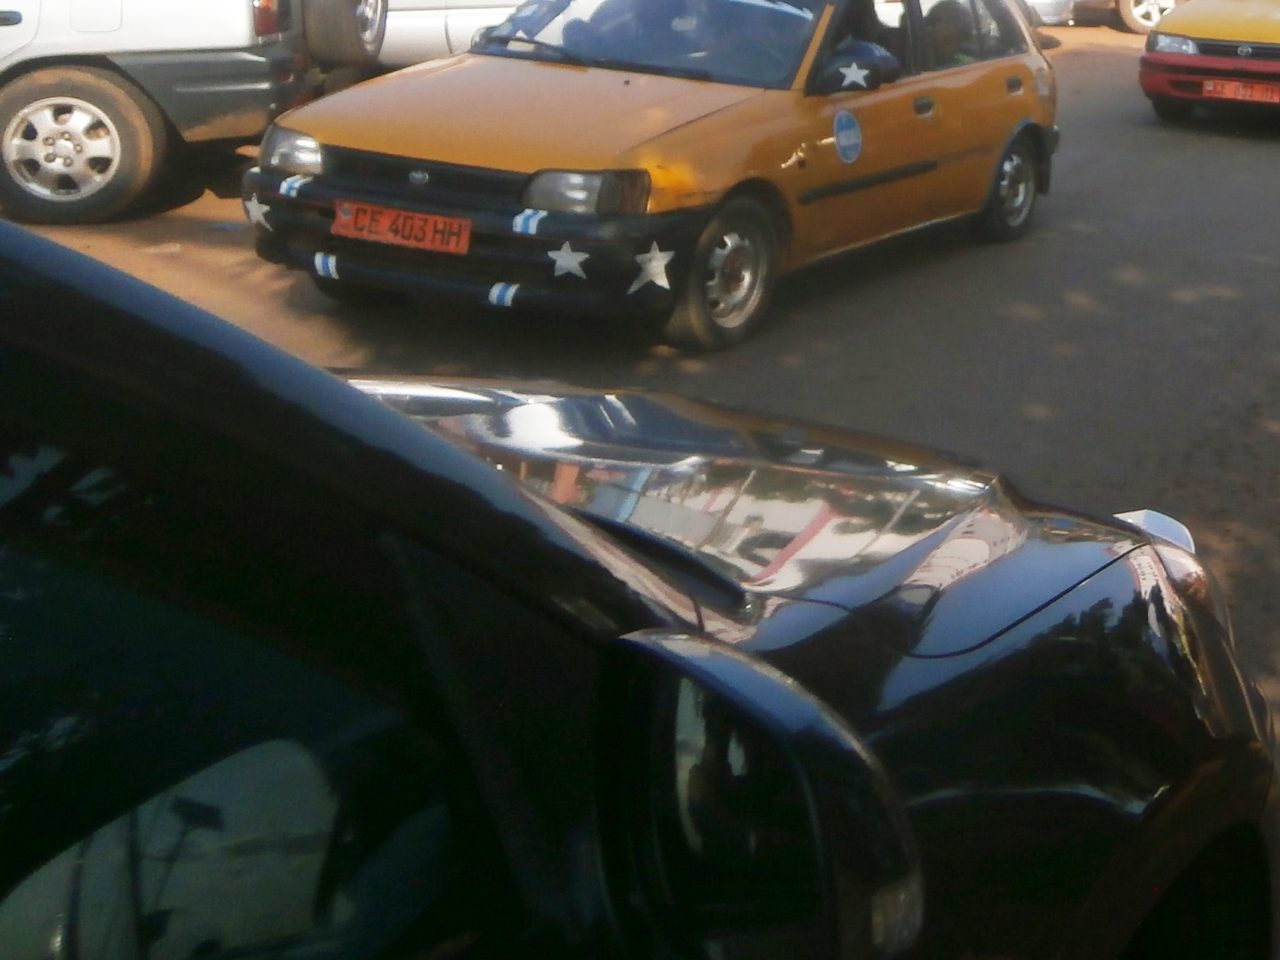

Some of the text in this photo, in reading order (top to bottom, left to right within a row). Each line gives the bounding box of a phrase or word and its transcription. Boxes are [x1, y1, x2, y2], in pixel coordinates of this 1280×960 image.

[353, 207, 463, 247] CE 403 HH
